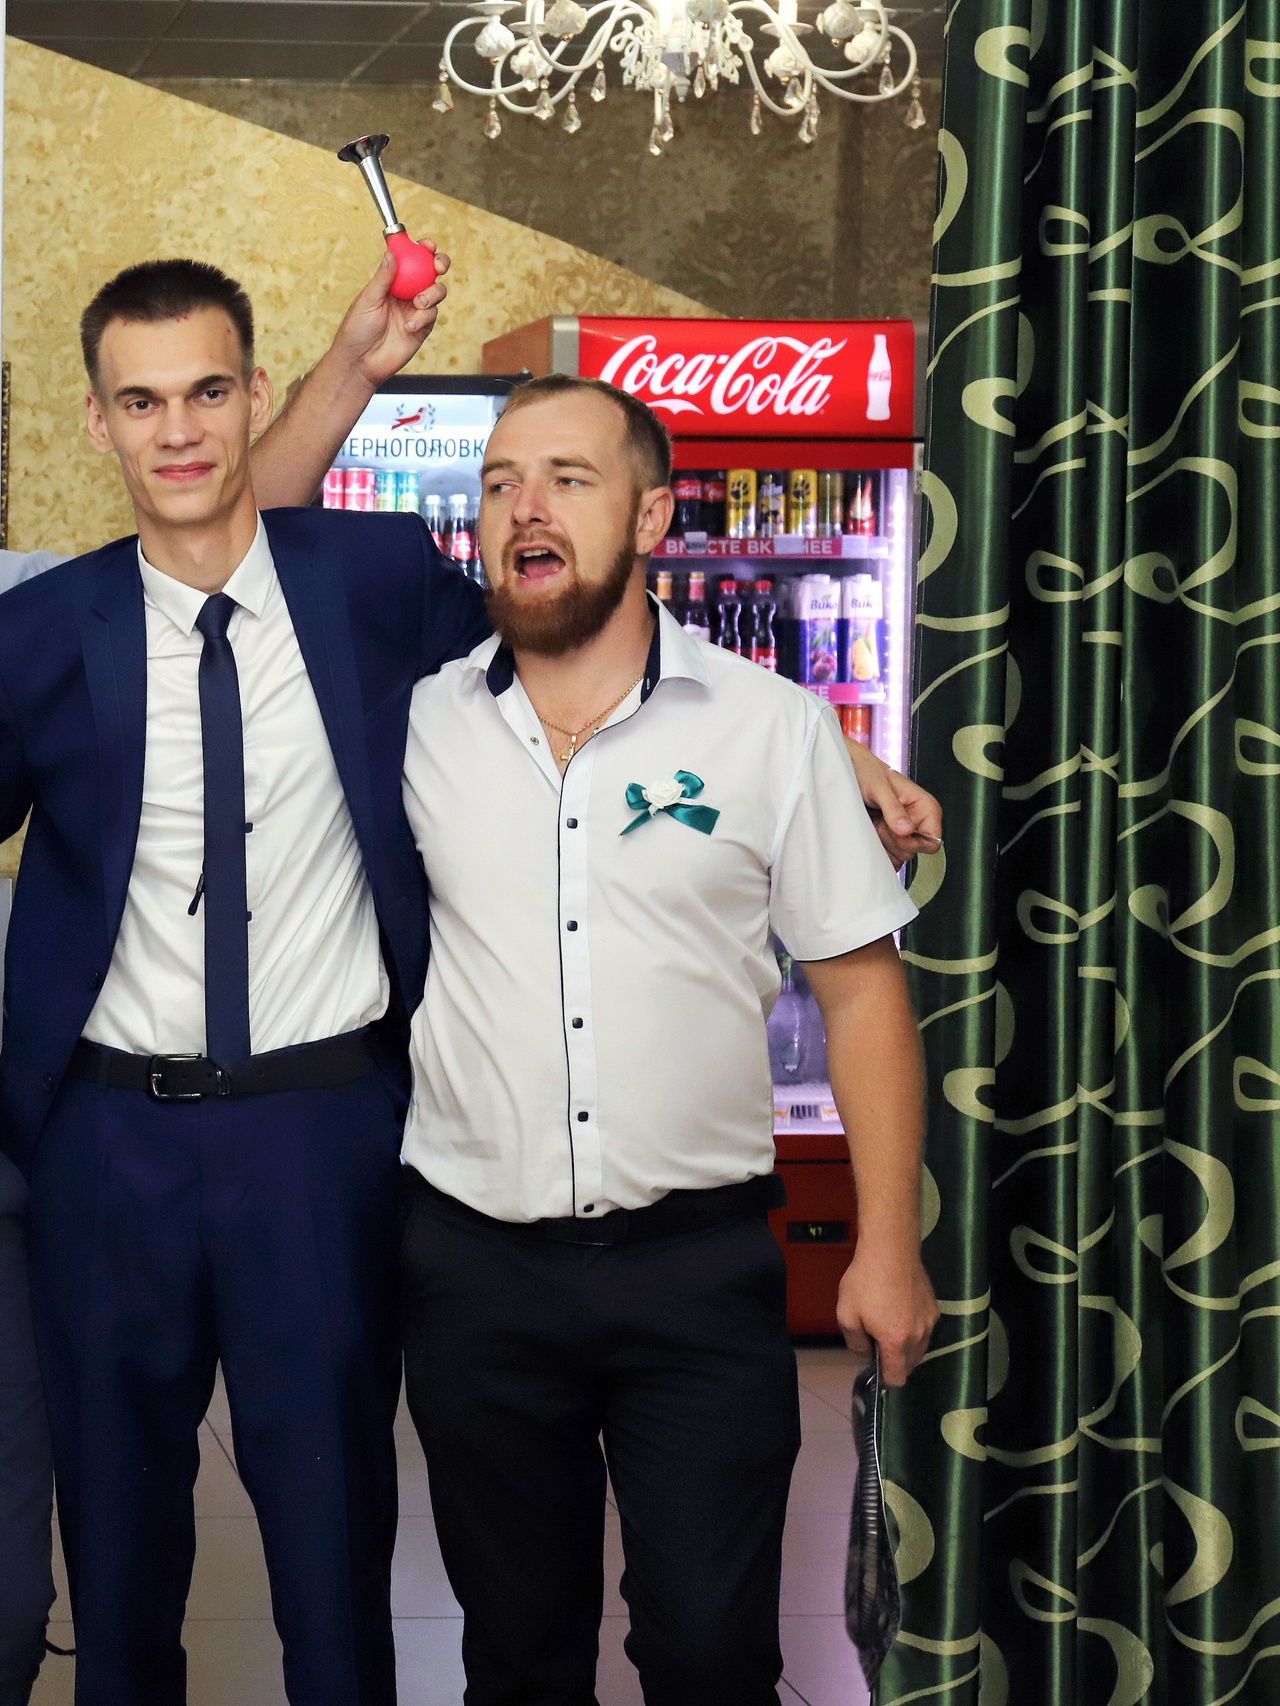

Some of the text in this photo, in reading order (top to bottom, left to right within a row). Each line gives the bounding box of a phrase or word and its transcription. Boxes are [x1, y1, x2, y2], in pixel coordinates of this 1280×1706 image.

[598, 334, 849, 416] Coca-Cola
[340, 437, 486, 459] ЕРНОГОЛОВК
[746, 539, 833, 555] ВКЕЕ
